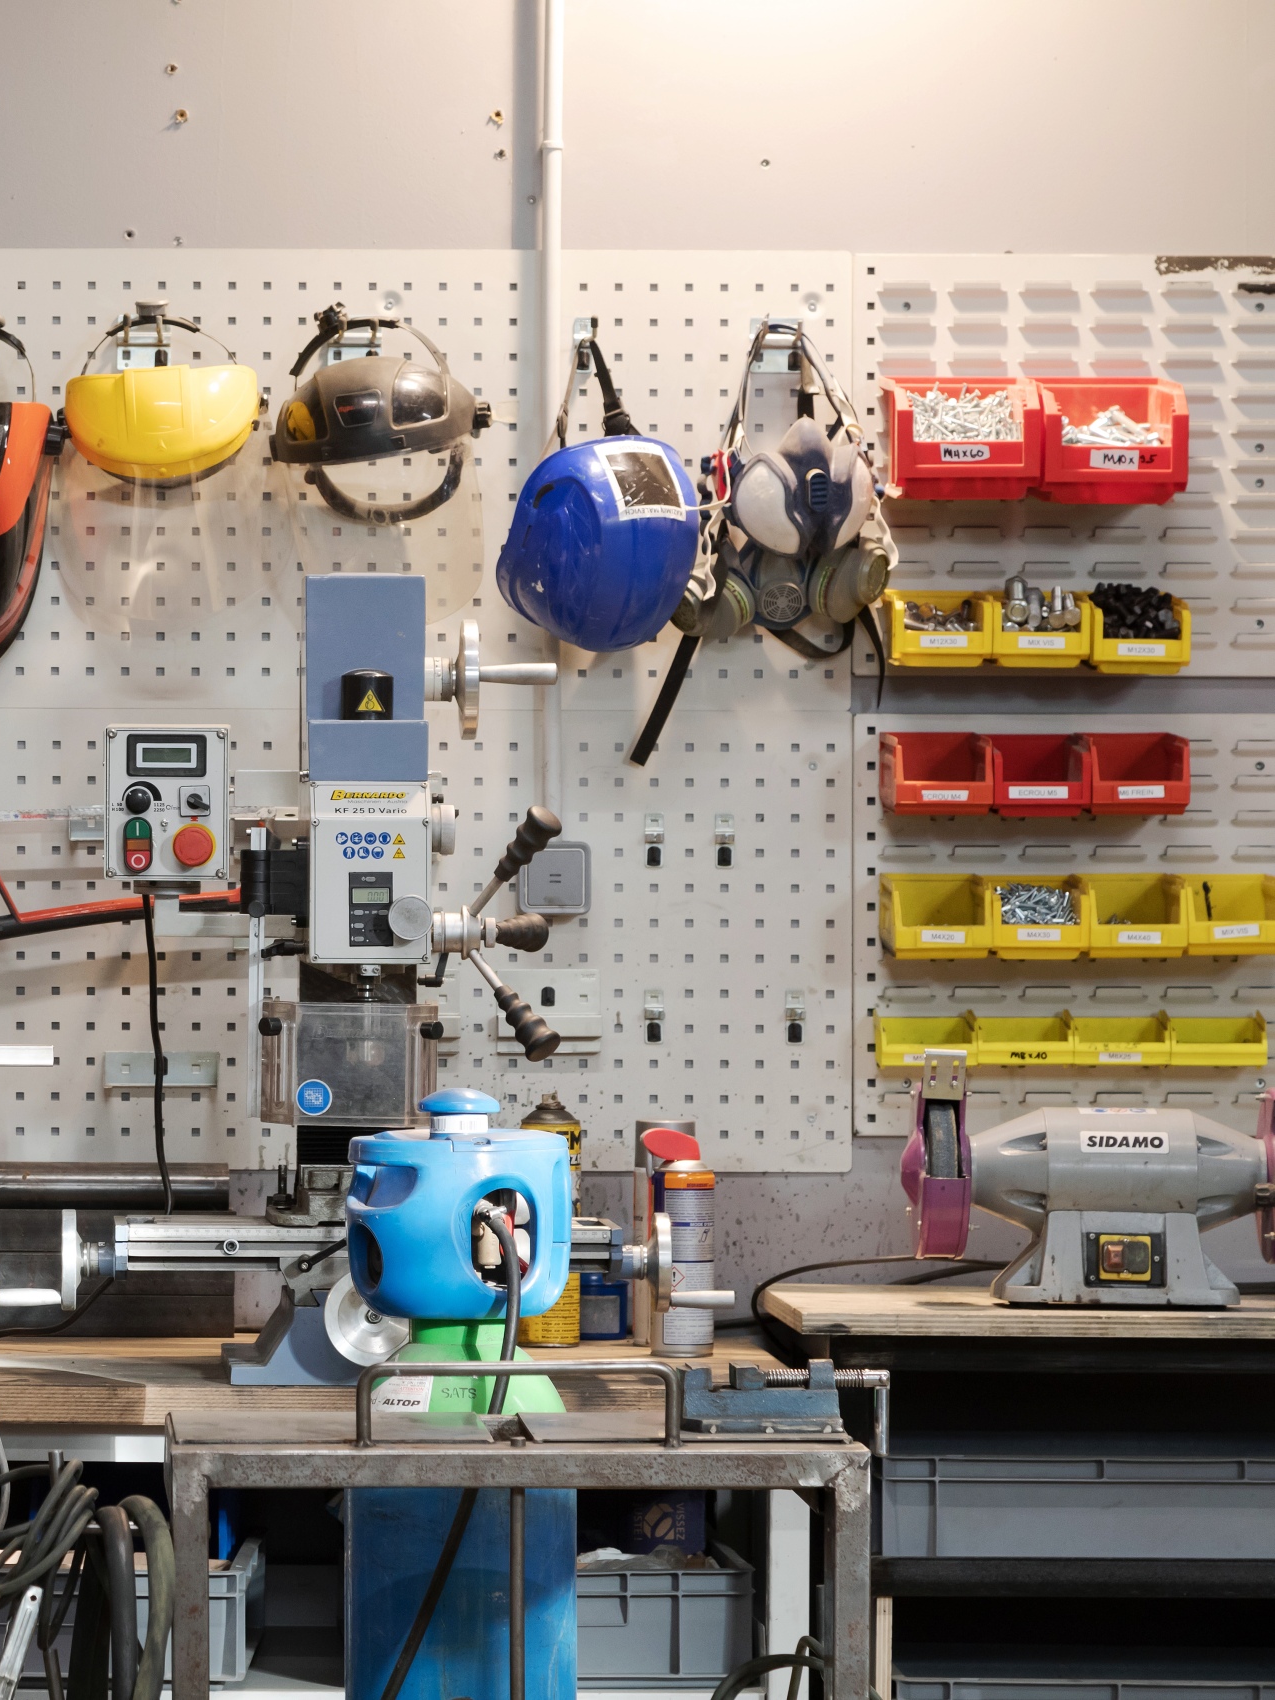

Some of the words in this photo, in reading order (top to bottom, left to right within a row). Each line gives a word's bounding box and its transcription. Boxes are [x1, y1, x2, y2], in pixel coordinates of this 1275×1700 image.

[1127, 646, 1156, 654] M12X30
[330, 789, 407, 800] BERNARDO
[931, 933, 955, 941] M4X20
[1086, 1135, 1164, 1149] SIDAMO
[441, 1387, 477, 1399] SATS
[382, 1398, 421, 1407] ALTOP
[675, 1502, 686, 1541] VISSEZ
